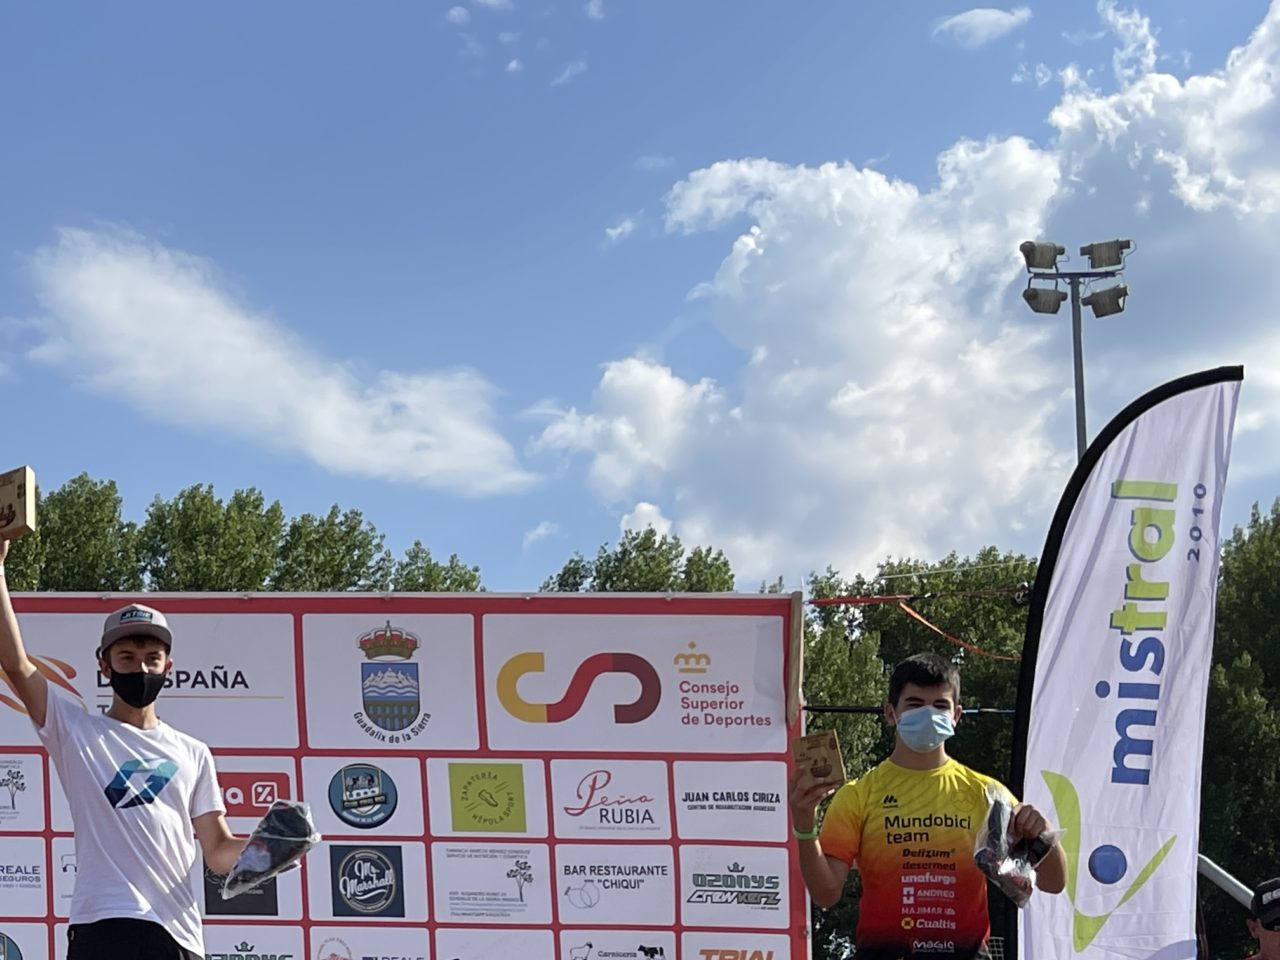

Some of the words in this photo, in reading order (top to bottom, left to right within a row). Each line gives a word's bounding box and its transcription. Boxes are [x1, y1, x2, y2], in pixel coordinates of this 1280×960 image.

[1187, 483, 1208, 563] 2010
[1095, 480, 1178, 786] mistral
[679, 680, 739, 695] Consejo
[680, 697, 744, 712] Superior
[353, 711, 386, 743] Guadalix
[389, 733, 400, 744] de
[402, 731, 412, 742] la
[411, 712, 432, 737] Sierra
[681, 713, 700, 726] de
[704, 713, 772, 728] Deportes
[563, 769, 655, 817] Peña
[681, 791, 709, 802] JUAN
[712, 791, 750, 802] CARLOS
[752, 792, 781, 804] CIRIZA
[599, 808, 655, 824] RUBIA
[884, 814, 971, 830] Mundobici
[886, 831, 929, 845] team
[563, 865, 587, 876] BAR
[589, 865, 668, 877] RESTAURANTE
[339, 867, 396, 899] Marshall
[597, 878, 645, 890] "CHIQUI"
[916, 919, 956, 930] Cualtis
